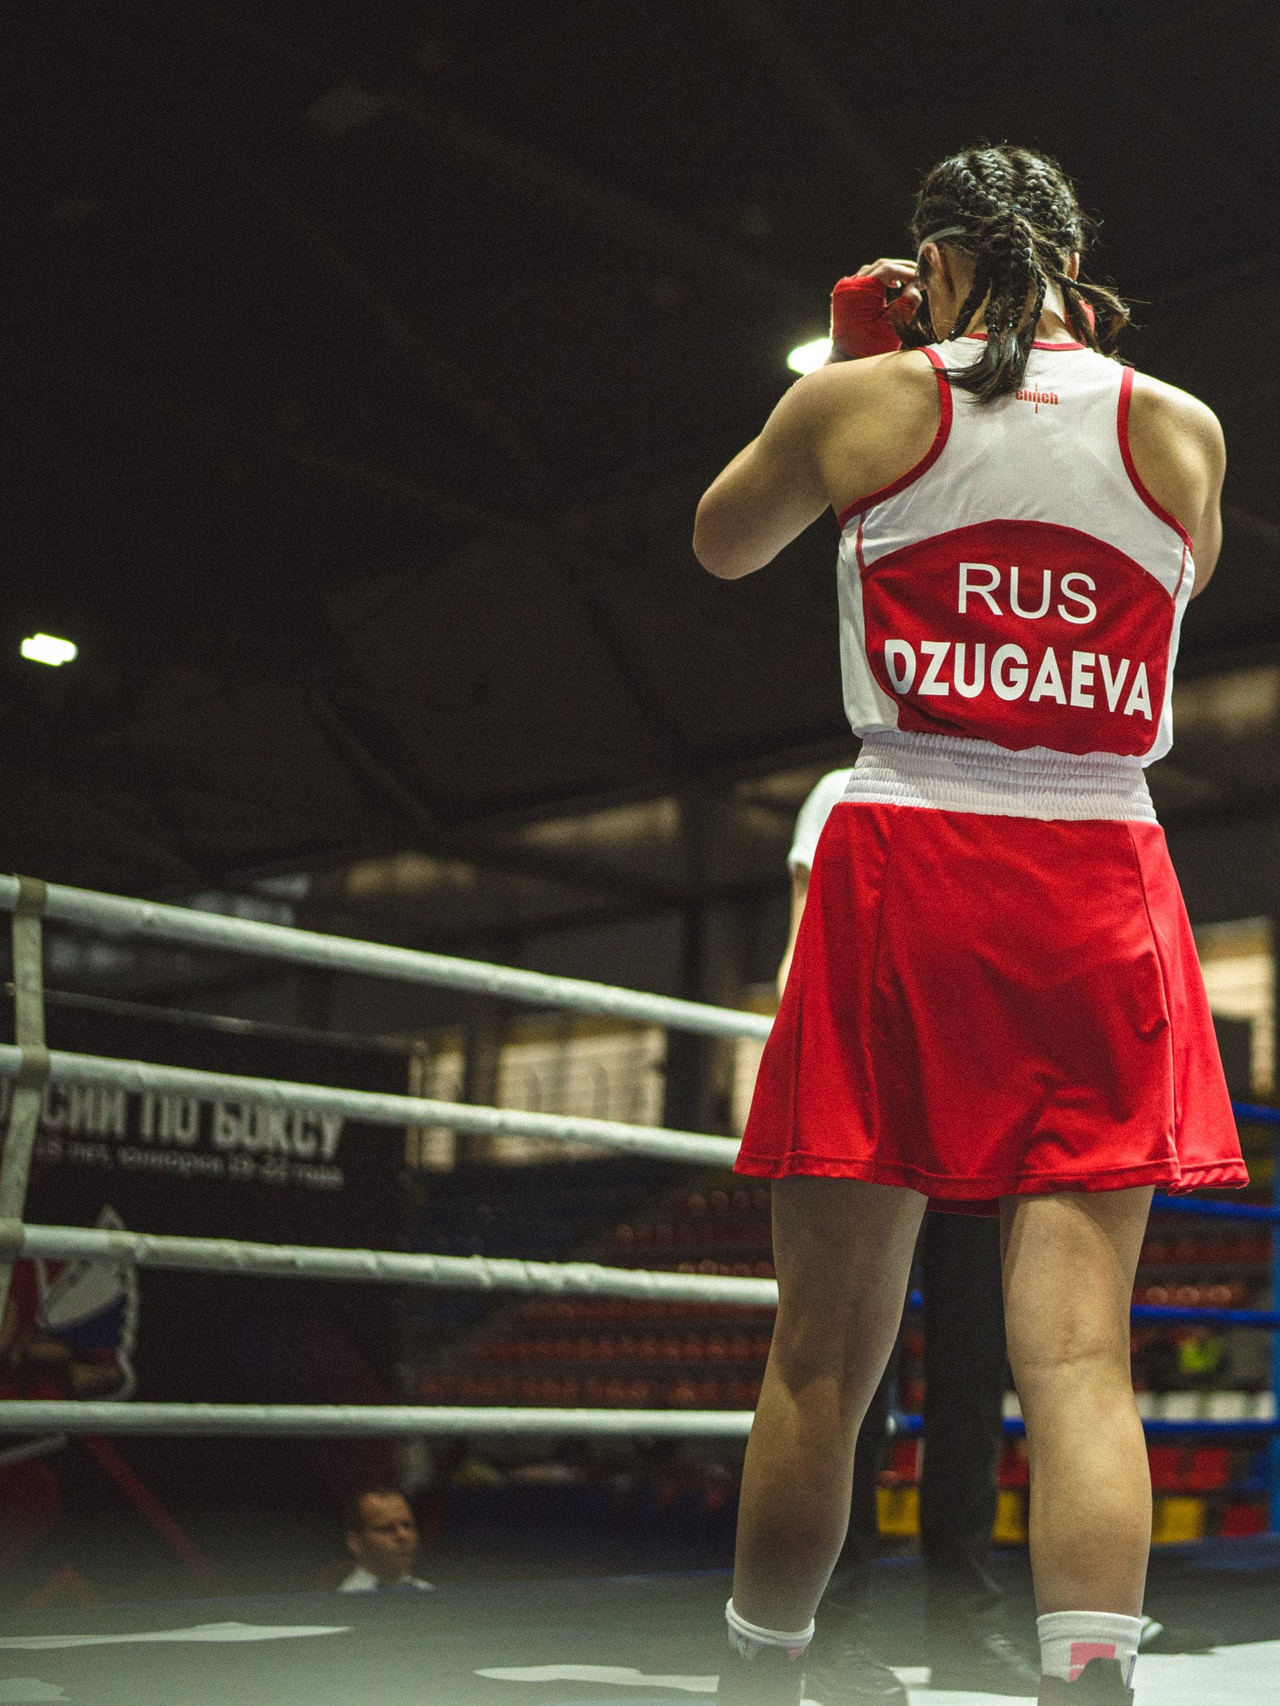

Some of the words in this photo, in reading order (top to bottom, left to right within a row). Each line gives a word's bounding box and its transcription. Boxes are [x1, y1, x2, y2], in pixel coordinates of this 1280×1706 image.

[1015, 389, 1059, 405] clinch
[957, 562, 1098, 625] RUS
[884, 638, 1154, 721] DZUGAEVA
